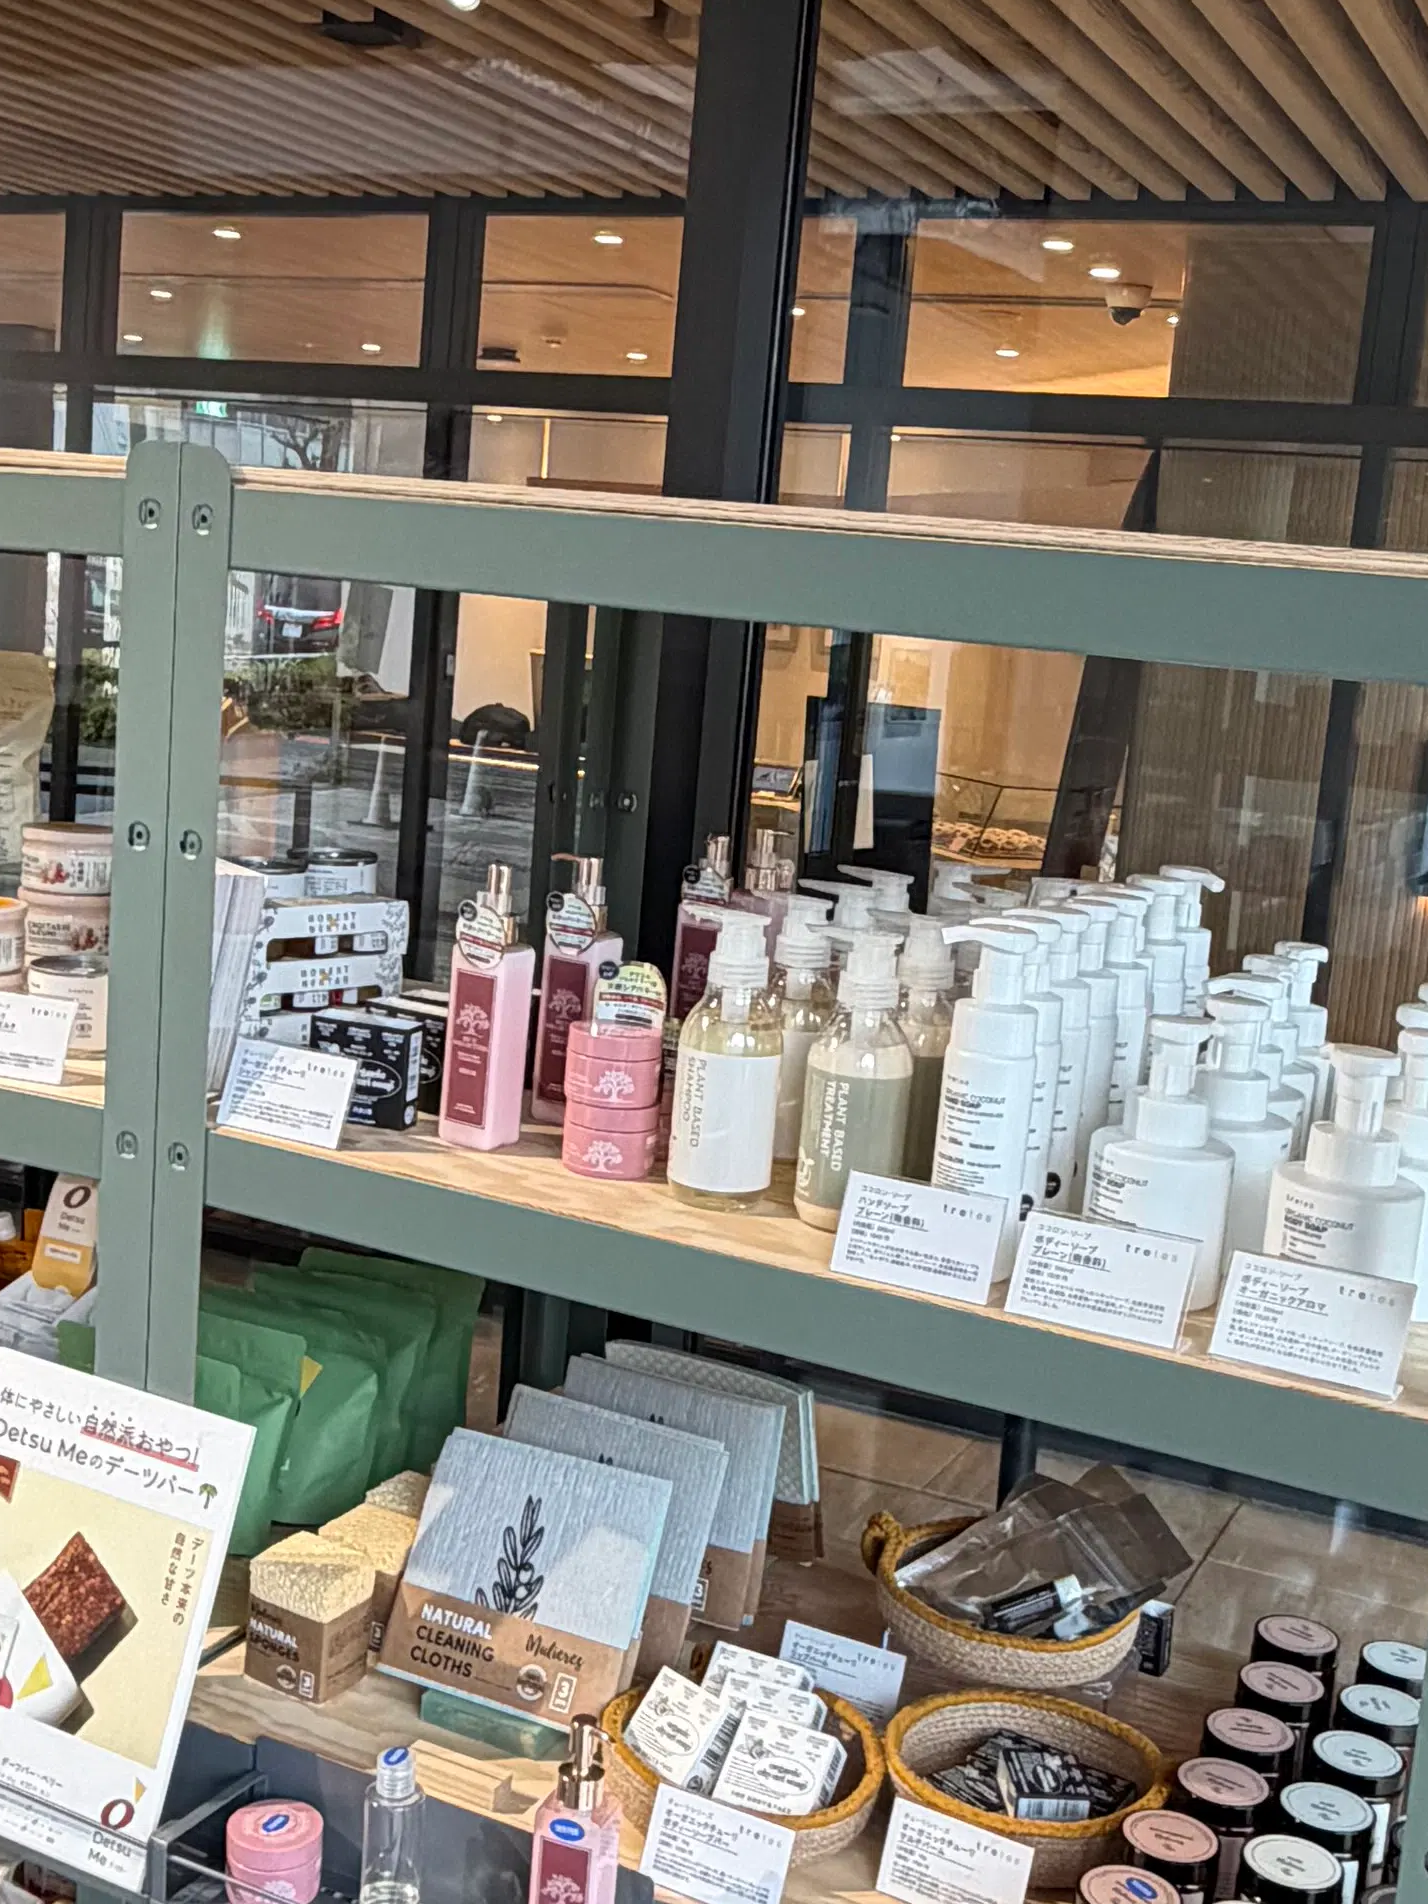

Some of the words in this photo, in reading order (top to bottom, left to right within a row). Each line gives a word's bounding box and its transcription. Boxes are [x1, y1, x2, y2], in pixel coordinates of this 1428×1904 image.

[695, 1058, 708, 1099] PLANT
[820, 1079, 837, 1158] TREATMENT
[836, 1081, 850, 1125] PLANT
[689, 1104, 704, 1148] BASED
[830, 1127, 846, 1172] BASED
[1314, 1215, 1356, 1231] COCONUT
[57, 1438, 194, 1495] Meのデーツバー
[160, 1532, 186, 1606] 自然な甘さ
[172, 1536, 205, 1626] デーツ本来の
[248, 1619, 299, 1650] NATURAL
[421, 1602, 494, 1642] NATURAL
[409, 1644, 473, 1680] CLOTHS
[415, 1624, 496, 1663] CLEANING
[525, 1632, 587, 1674] Mulieres
[556, 1679, 572, 1700] 3
[87, 1846, 108, 1868] Me
[91, 1830, 133, 1858] Detsu
